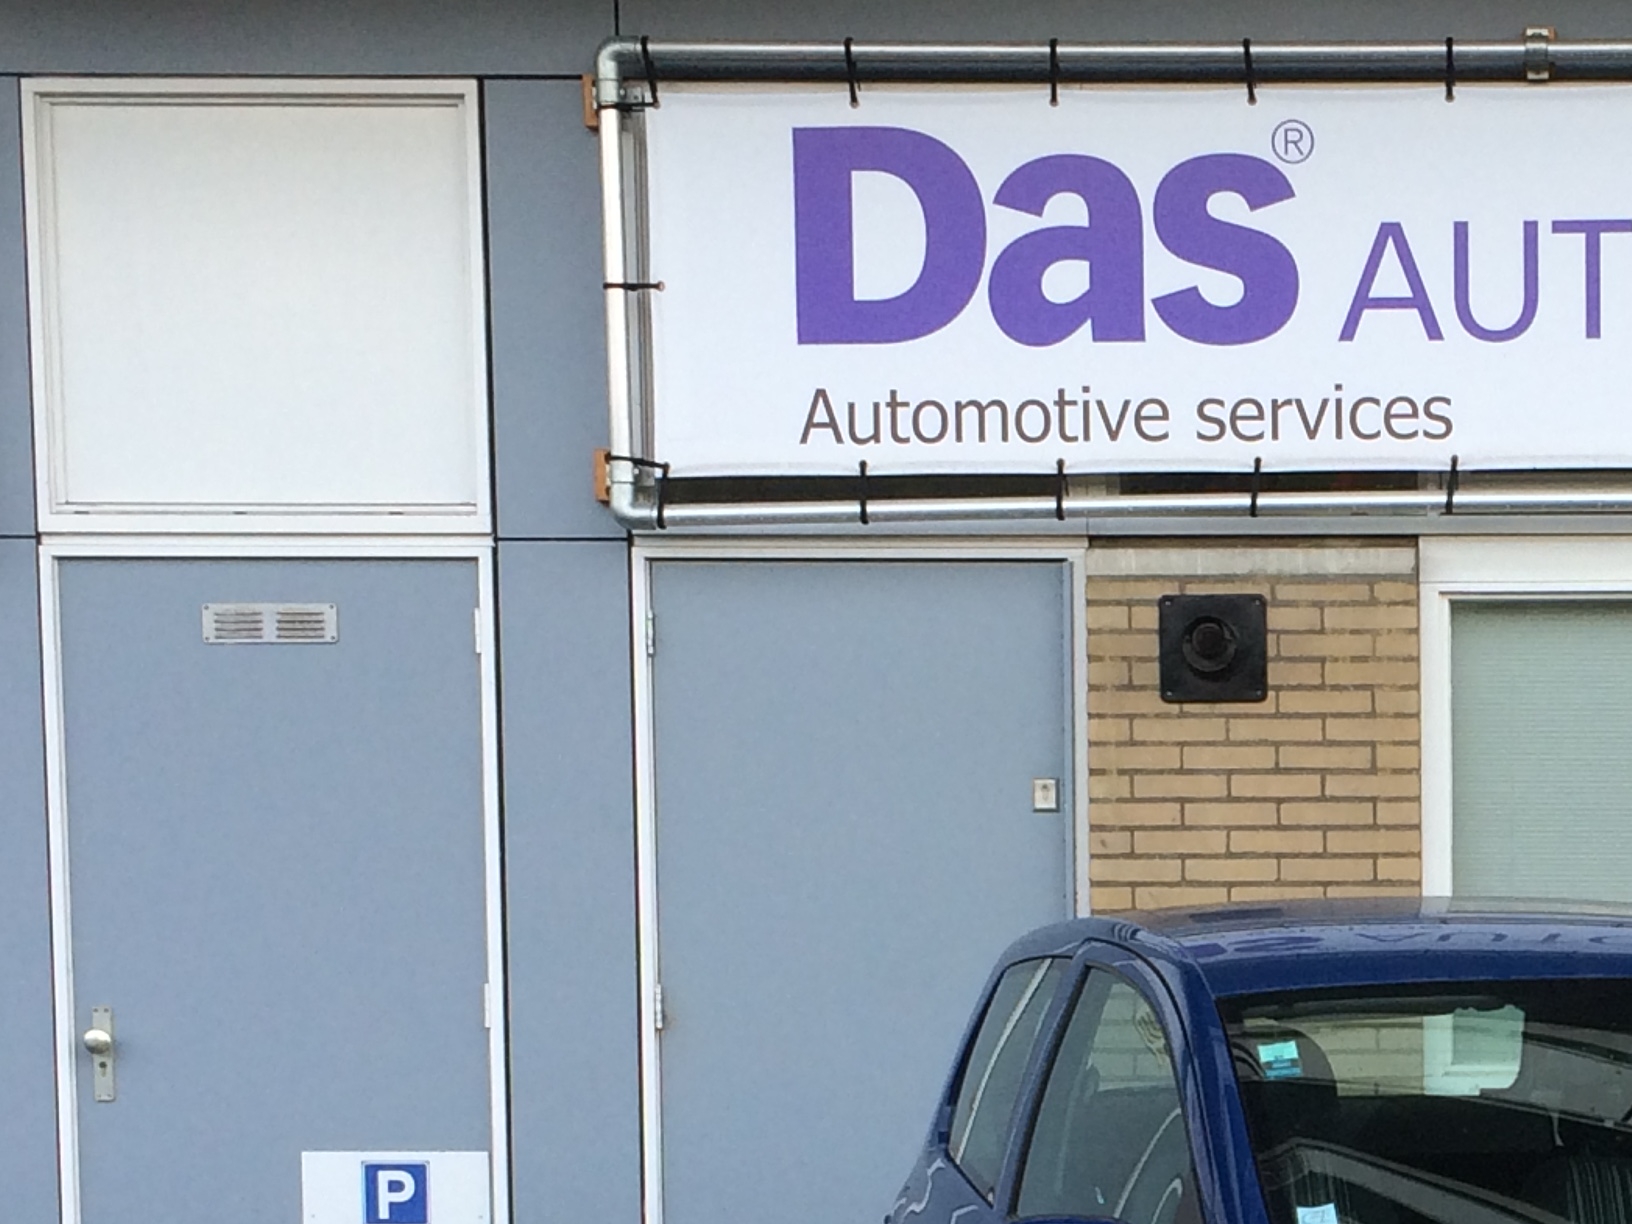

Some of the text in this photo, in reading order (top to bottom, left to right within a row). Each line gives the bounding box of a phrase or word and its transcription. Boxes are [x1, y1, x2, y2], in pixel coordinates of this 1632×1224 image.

[800, 384, 1453, 445] Automotive services
[377, 1170, 415, 1220] P
